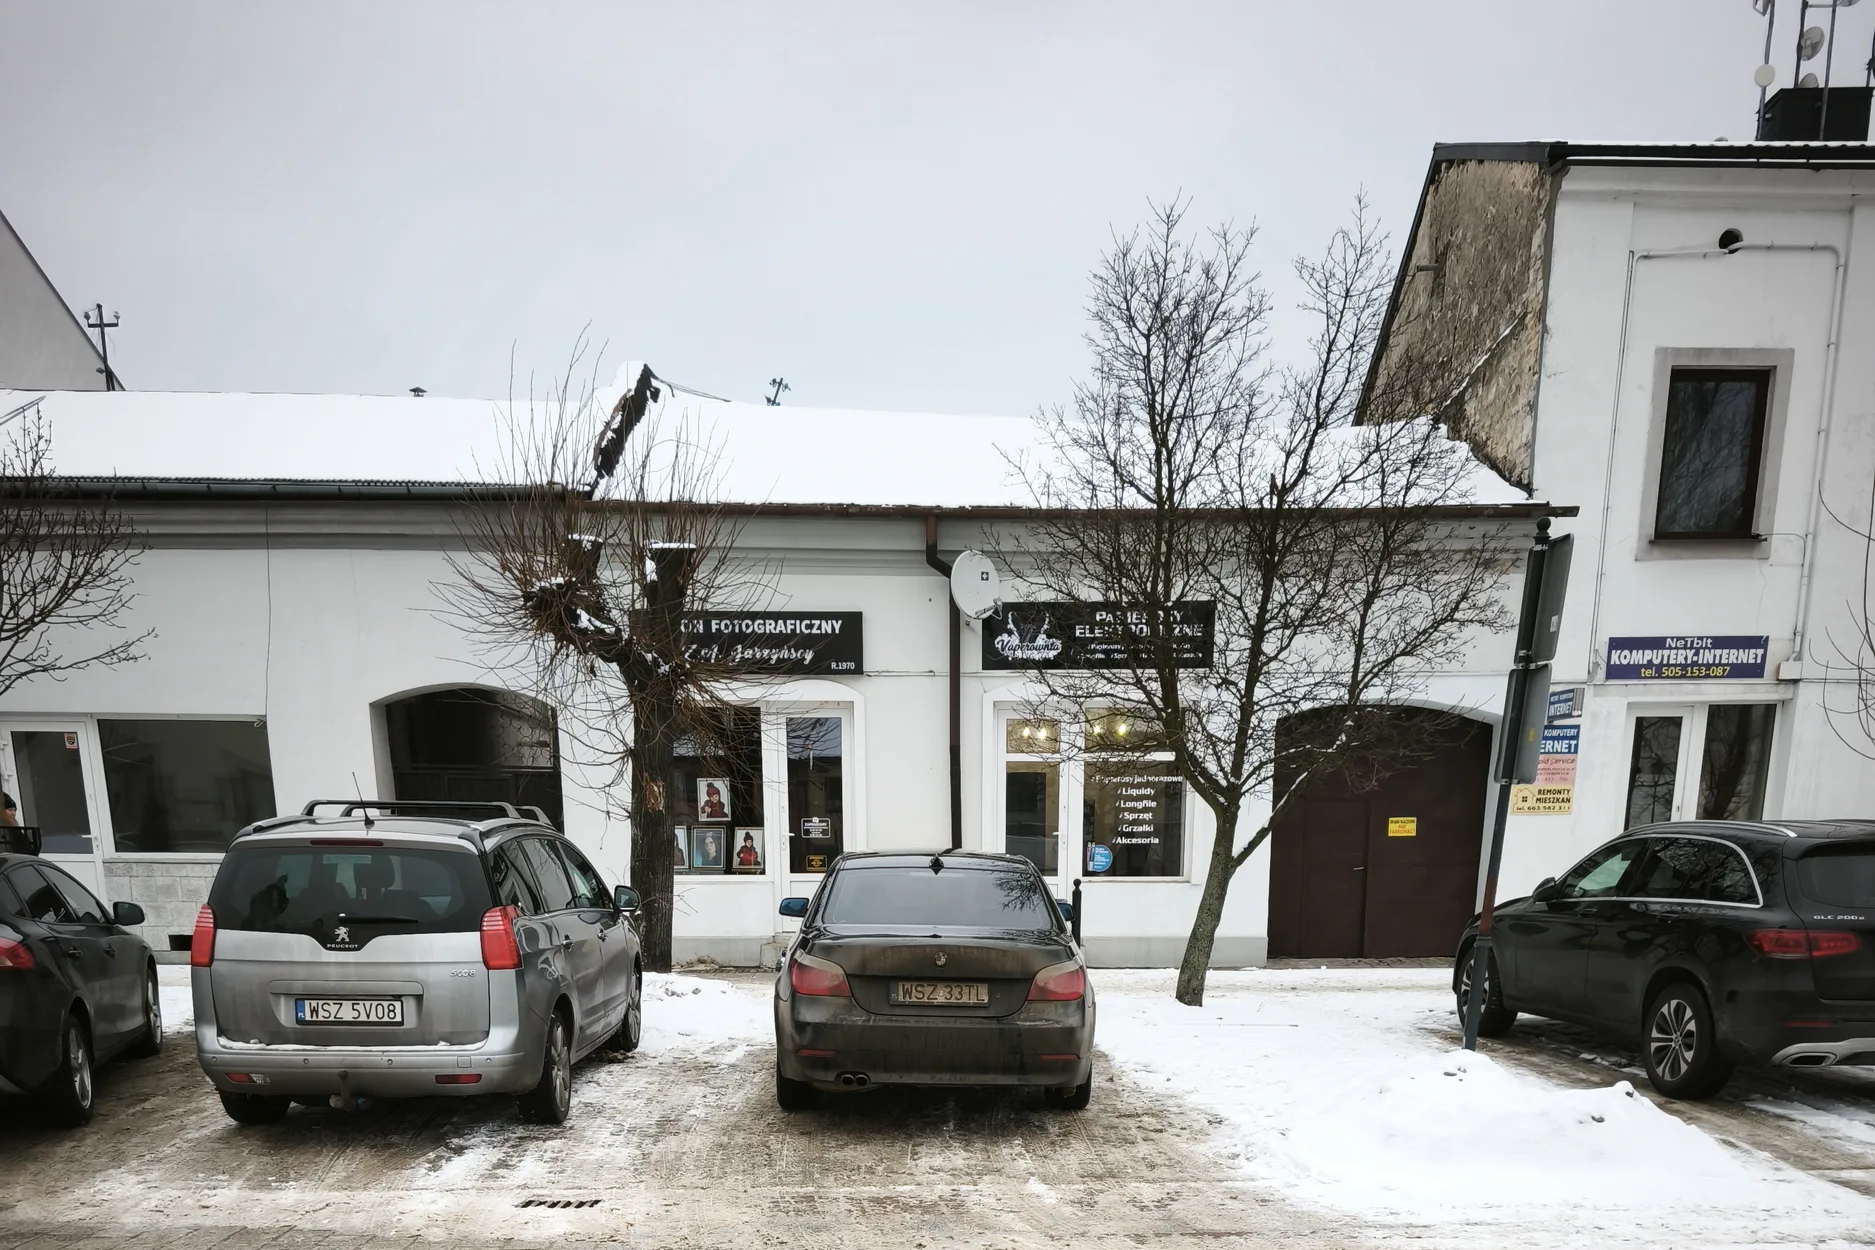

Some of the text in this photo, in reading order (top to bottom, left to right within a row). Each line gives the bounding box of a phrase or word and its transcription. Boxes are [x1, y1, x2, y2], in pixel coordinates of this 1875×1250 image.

[711, 619, 843, 634] FOTOGRAFICZNY
[1610, 648, 1765, 665] KOMPUTERY-INTERNET
[831, 661, 856, 670] R.1970
[1640, 666, 1731, 677] tel. 505-153-087
[1548, 701, 1573, 717] INTERNET
[1543, 728, 1578, 737] KOMPUTERY
[1537, 788, 1571, 796] REMONTY
[1535, 796, 1571, 804] MIESZKAŃ
[450, 969, 476, 978] 5008
[901, 983, 938, 1001] WSZ
[944, 984, 986, 1002] 33TL
[308, 1002, 344, 1020] WSZ
[351, 1002, 397, 1020] 5V08
